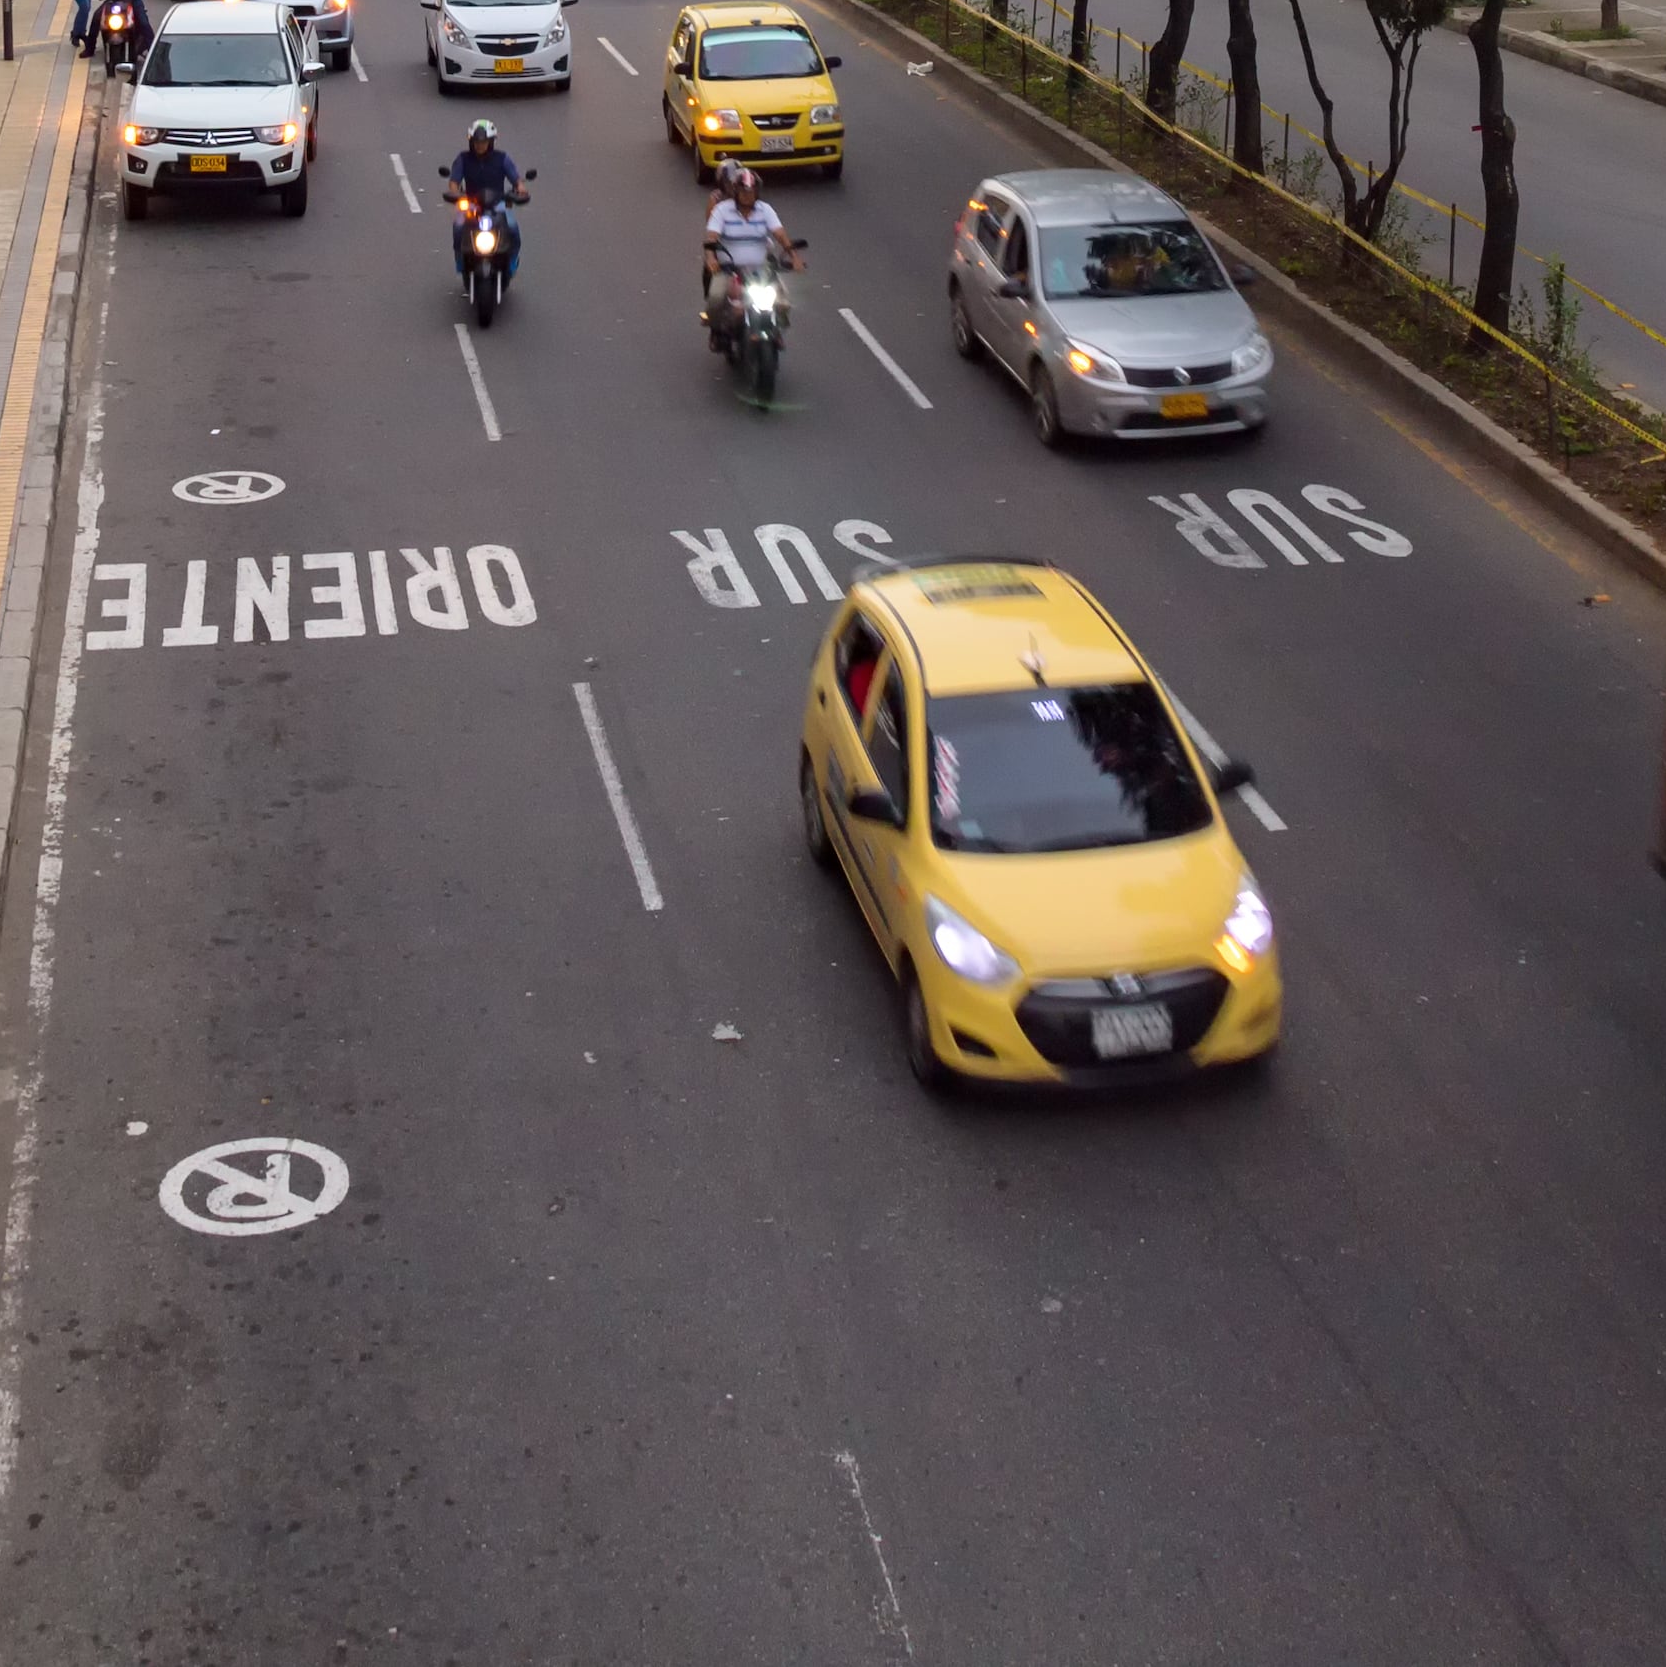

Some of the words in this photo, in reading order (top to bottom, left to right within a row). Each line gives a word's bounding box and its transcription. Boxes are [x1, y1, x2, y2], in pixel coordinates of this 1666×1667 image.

[671, 519, 908, 609] SUR
[1149, 483, 1414, 570] SUR
[86, 544, 538, 651] ORIENTE
